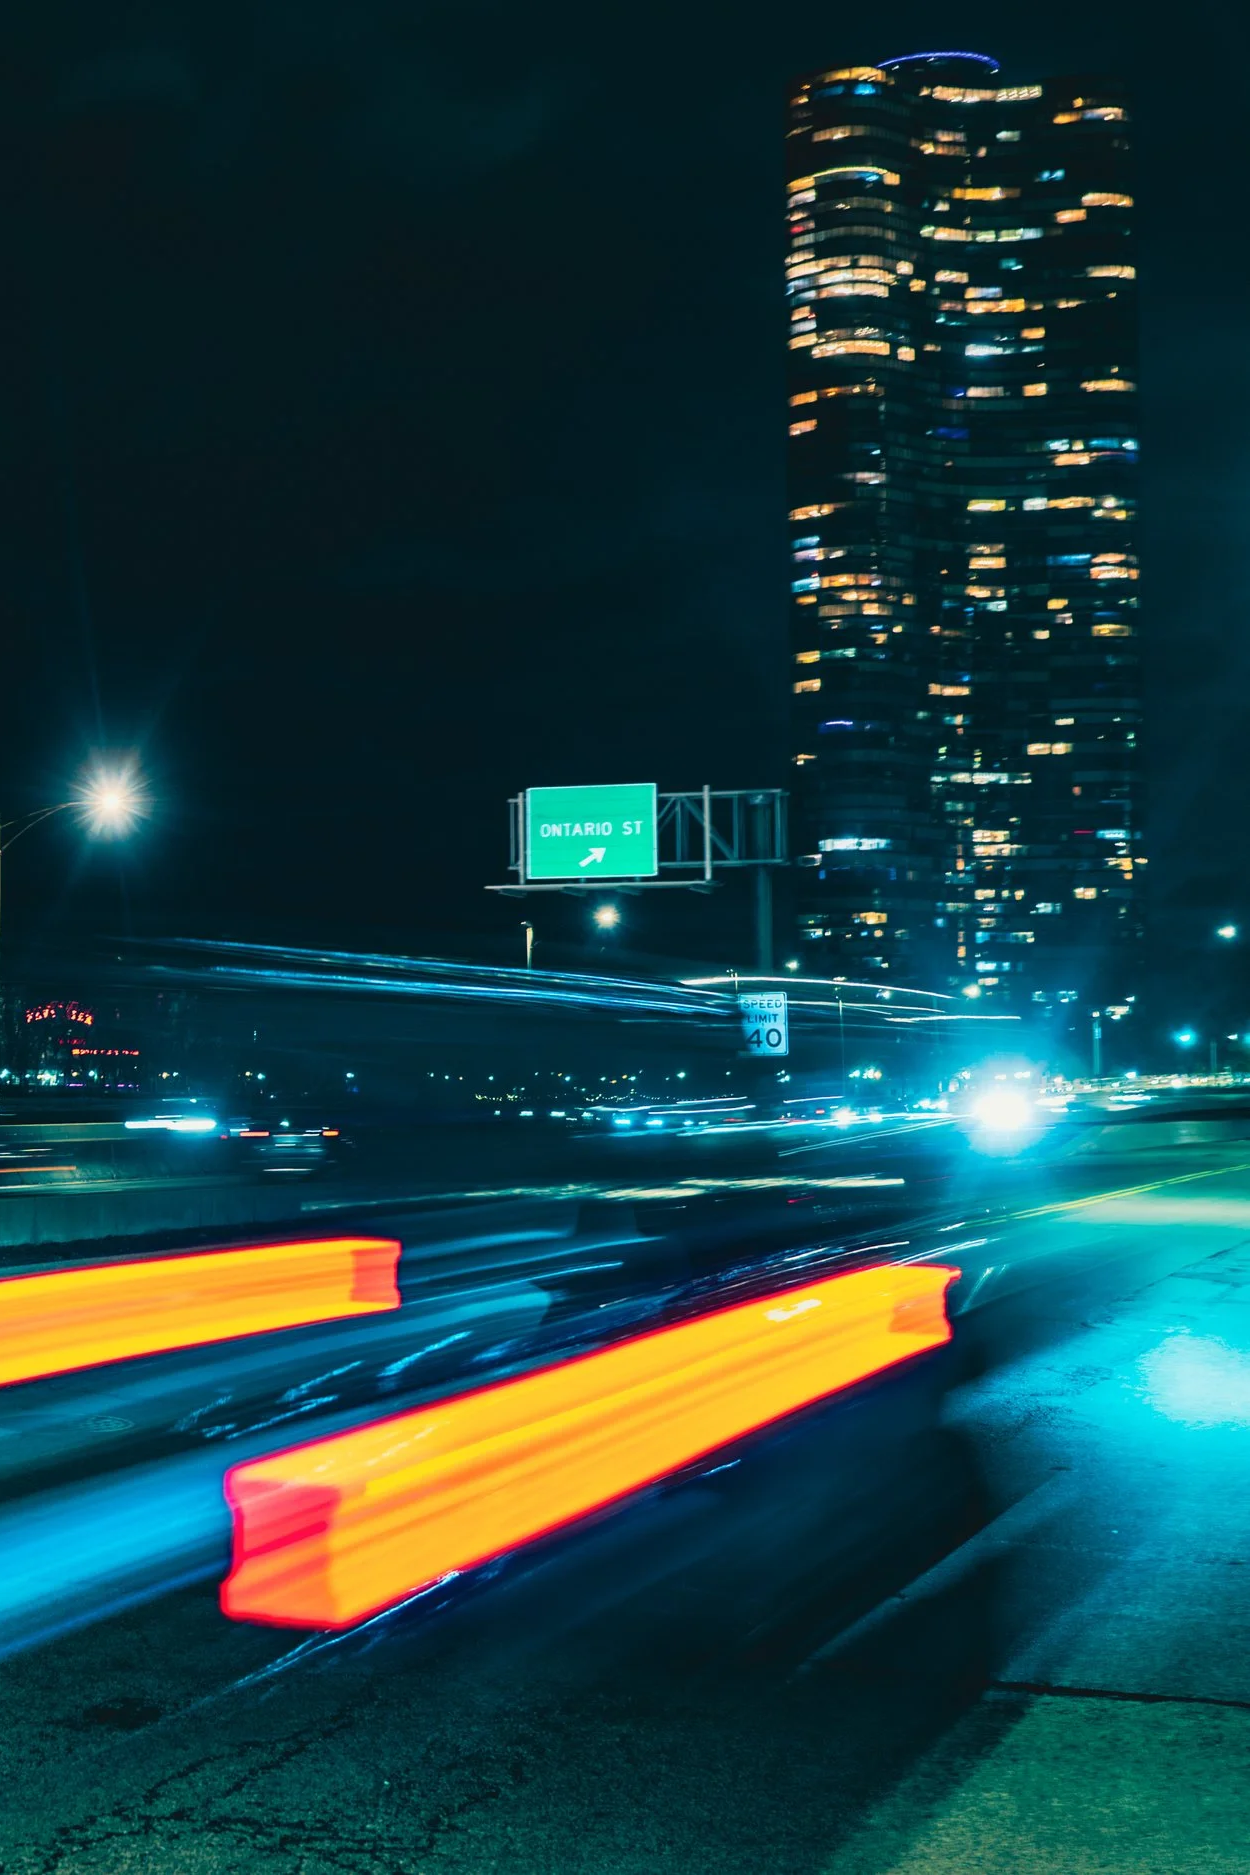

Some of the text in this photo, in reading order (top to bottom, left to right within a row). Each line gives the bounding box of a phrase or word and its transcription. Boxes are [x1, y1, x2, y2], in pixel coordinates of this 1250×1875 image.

[540, 820, 644, 838] ONTARIO ST
[743, 999, 783, 1009] SPEED
[747, 1013, 779, 1024] LIMIT
[746, 1027, 782, 1048] 40
